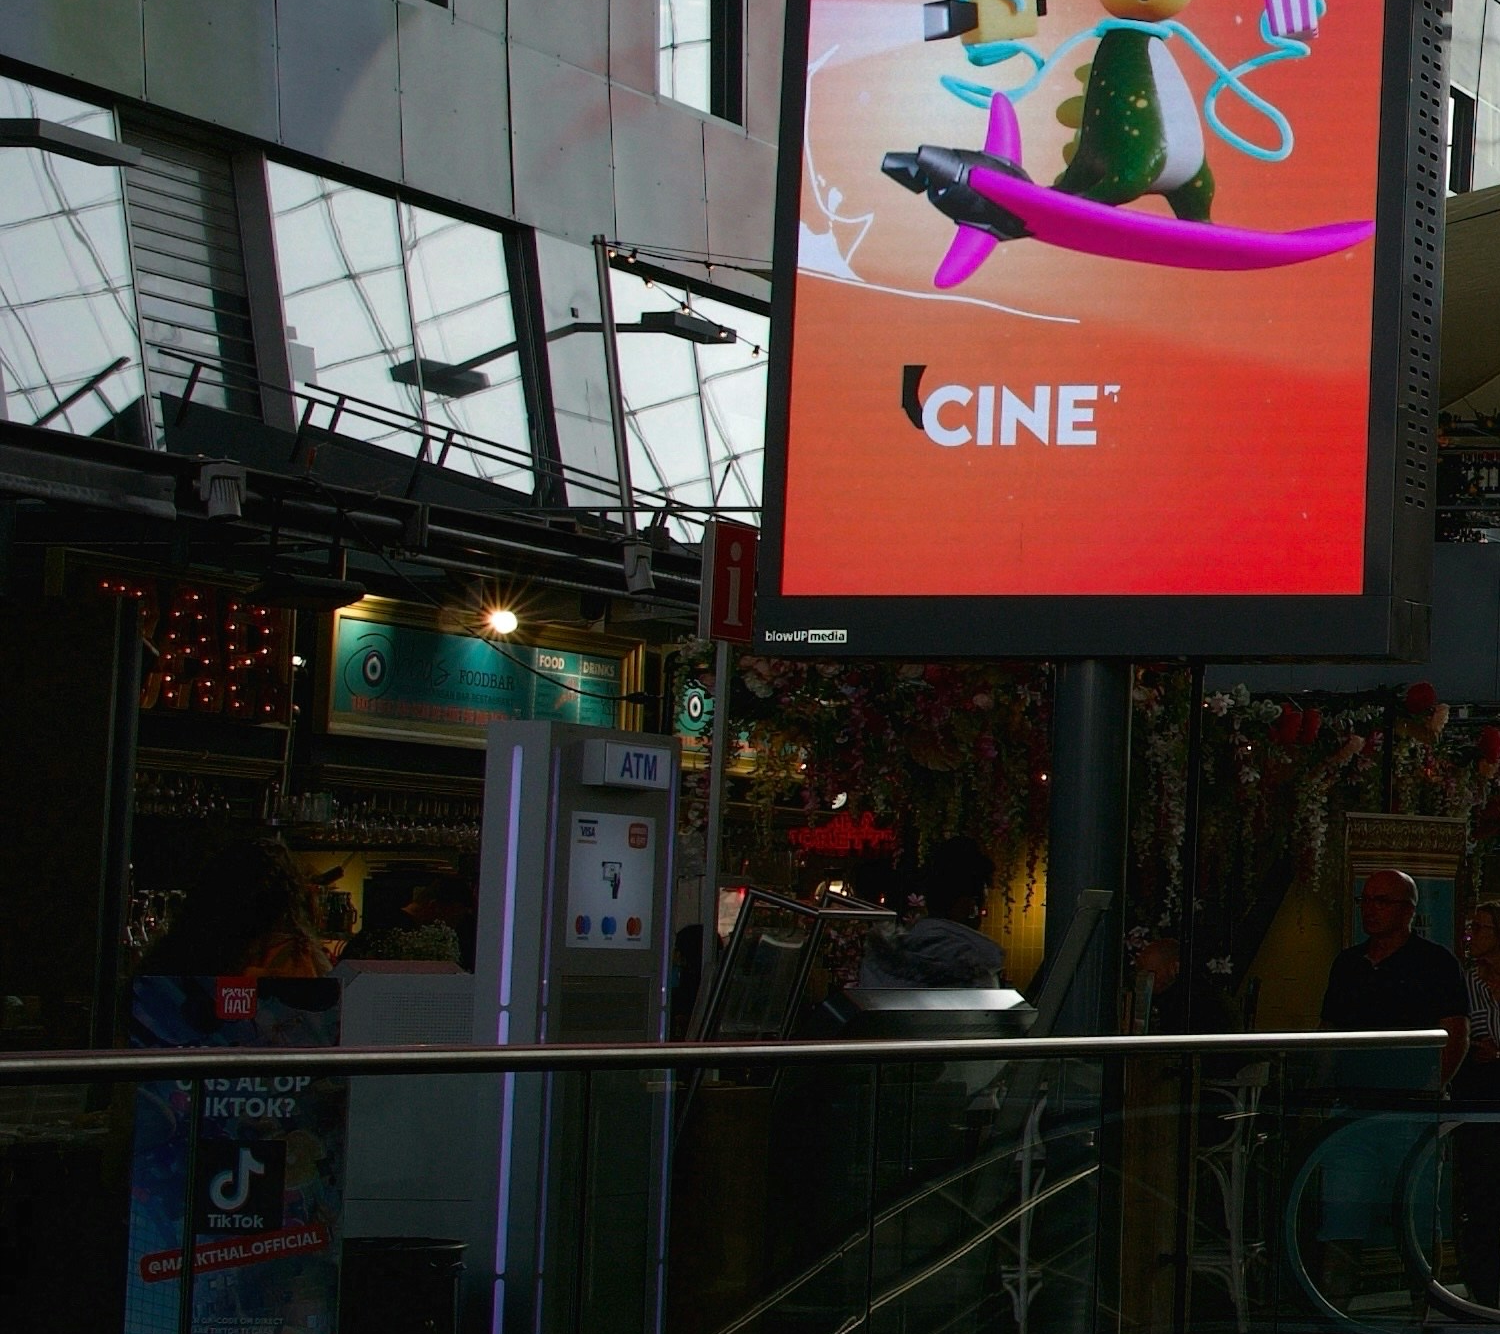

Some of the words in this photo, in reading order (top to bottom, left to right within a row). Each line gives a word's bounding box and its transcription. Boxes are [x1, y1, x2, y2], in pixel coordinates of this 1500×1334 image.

[921, 384, 1099, 447] CINE
[765, 629, 808, 643] blowUP
[809, 631, 847, 642] media
[539, 654, 565, 670] FOOD
[582, 661, 615, 677] DRINKS
[459, 669, 515, 691] FOODBAR
[620, 751, 658, 782] ATM
[207, 1214, 264, 1229] TikTok
